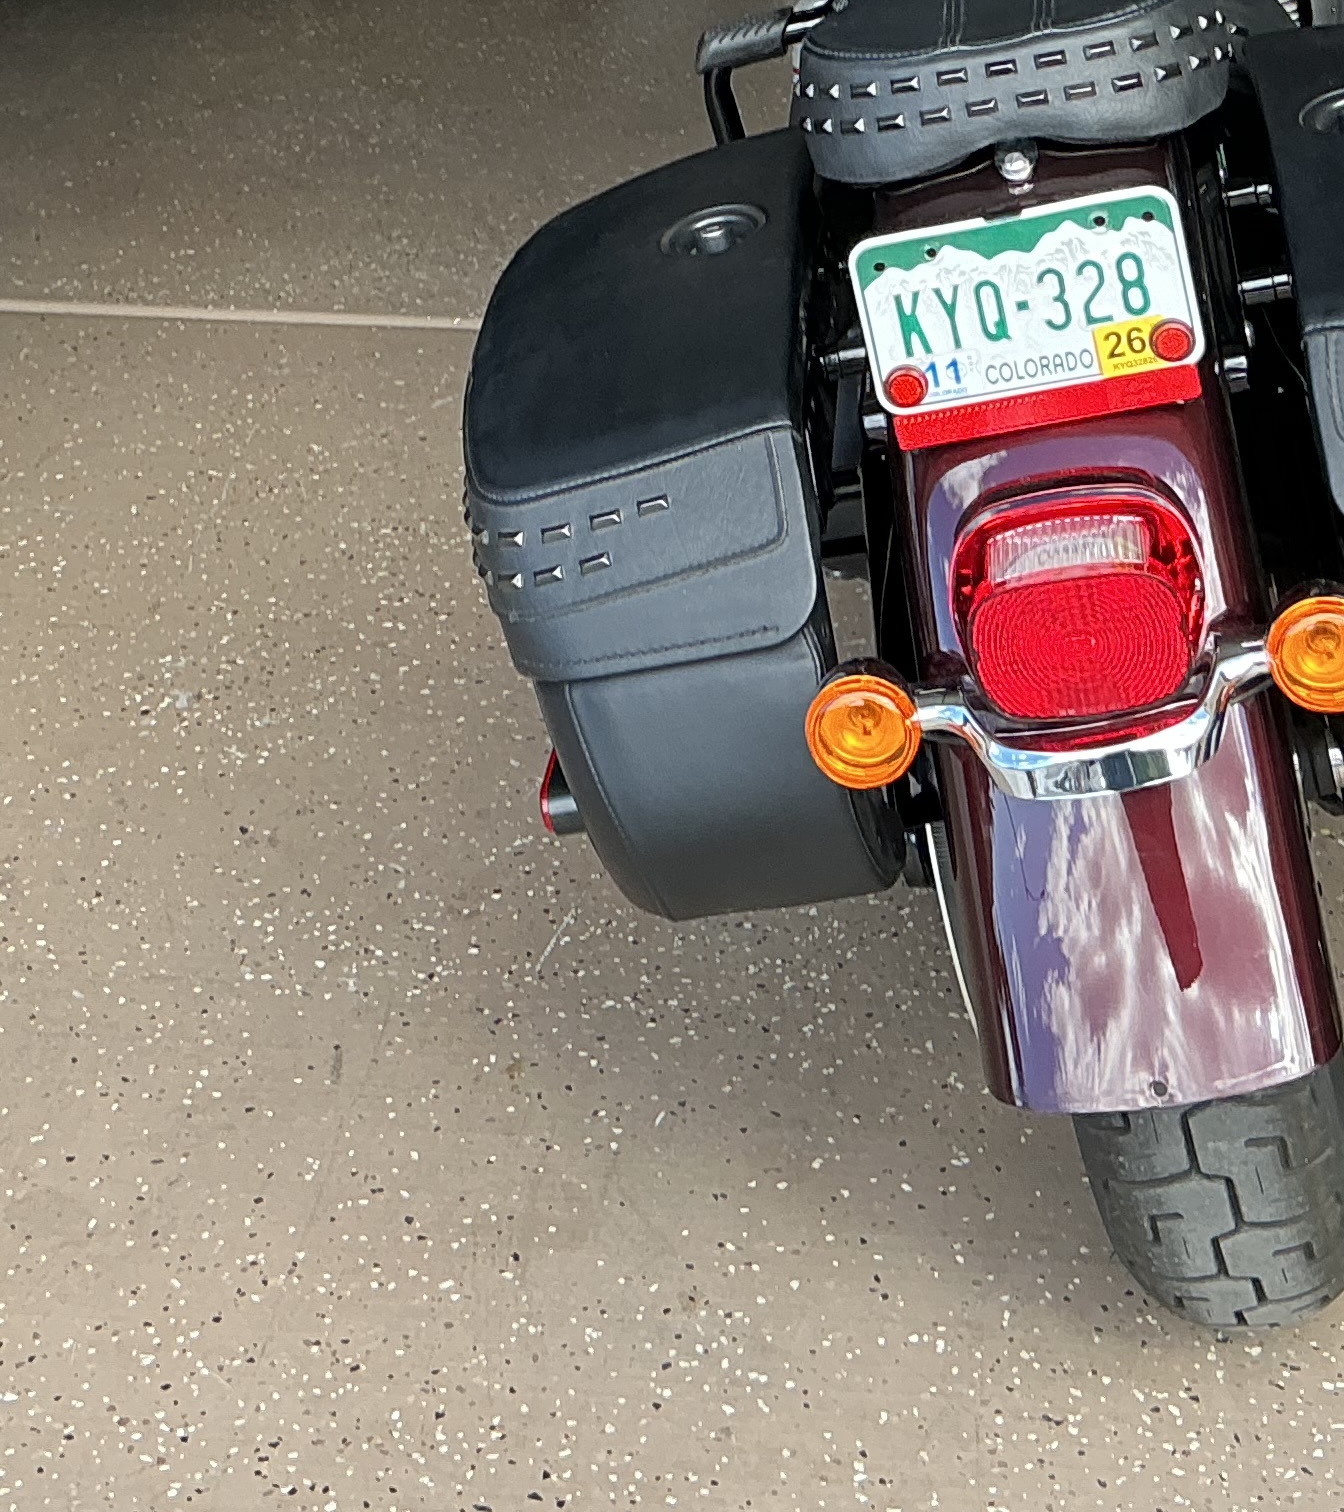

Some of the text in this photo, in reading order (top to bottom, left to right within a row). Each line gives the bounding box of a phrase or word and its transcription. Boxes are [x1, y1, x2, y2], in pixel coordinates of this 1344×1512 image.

[894, 251, 1151, 358] KYQ-328
[1103, 326, 1147, 360] 26
[924, 358, 962, 388] 11
[985, 348, 1095, 386] COLORADO
